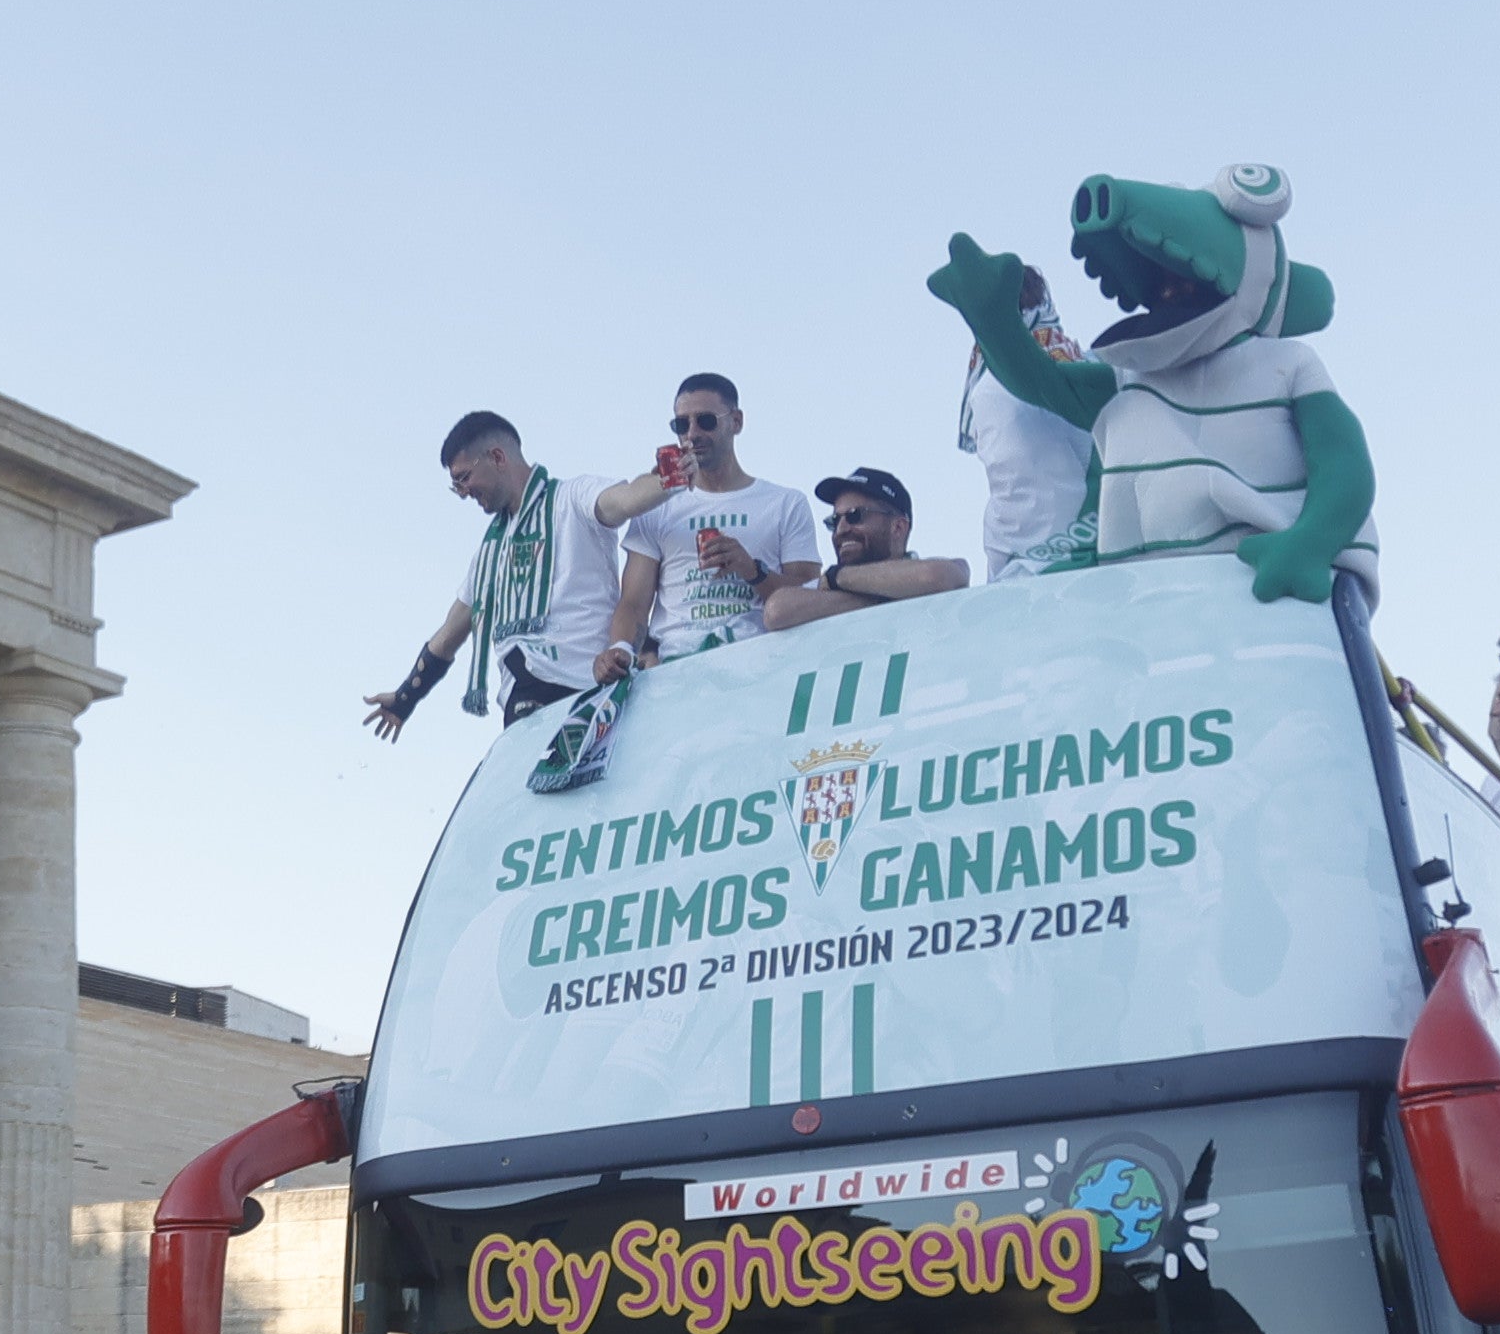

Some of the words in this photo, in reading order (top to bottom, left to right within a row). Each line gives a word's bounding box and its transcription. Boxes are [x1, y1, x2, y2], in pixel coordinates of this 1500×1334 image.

[690, 602, 752, 620] CREIMOS
[496, 789, 777, 893] SENTIMOS
[879, 709, 1233, 821] LUCHAMOS
[528, 866, 790, 967] CREIMOS
[859, 799, 1197, 912] GANAMOS
[544, 958, 688, 1015] ASCENSO
[699, 951, 736, 993] 2ª
[746, 924, 894, 982] DIVISIÓN
[906, 894, 1130, 960] 2023/2024
[712, 1158, 1007, 1213] Worldwide
